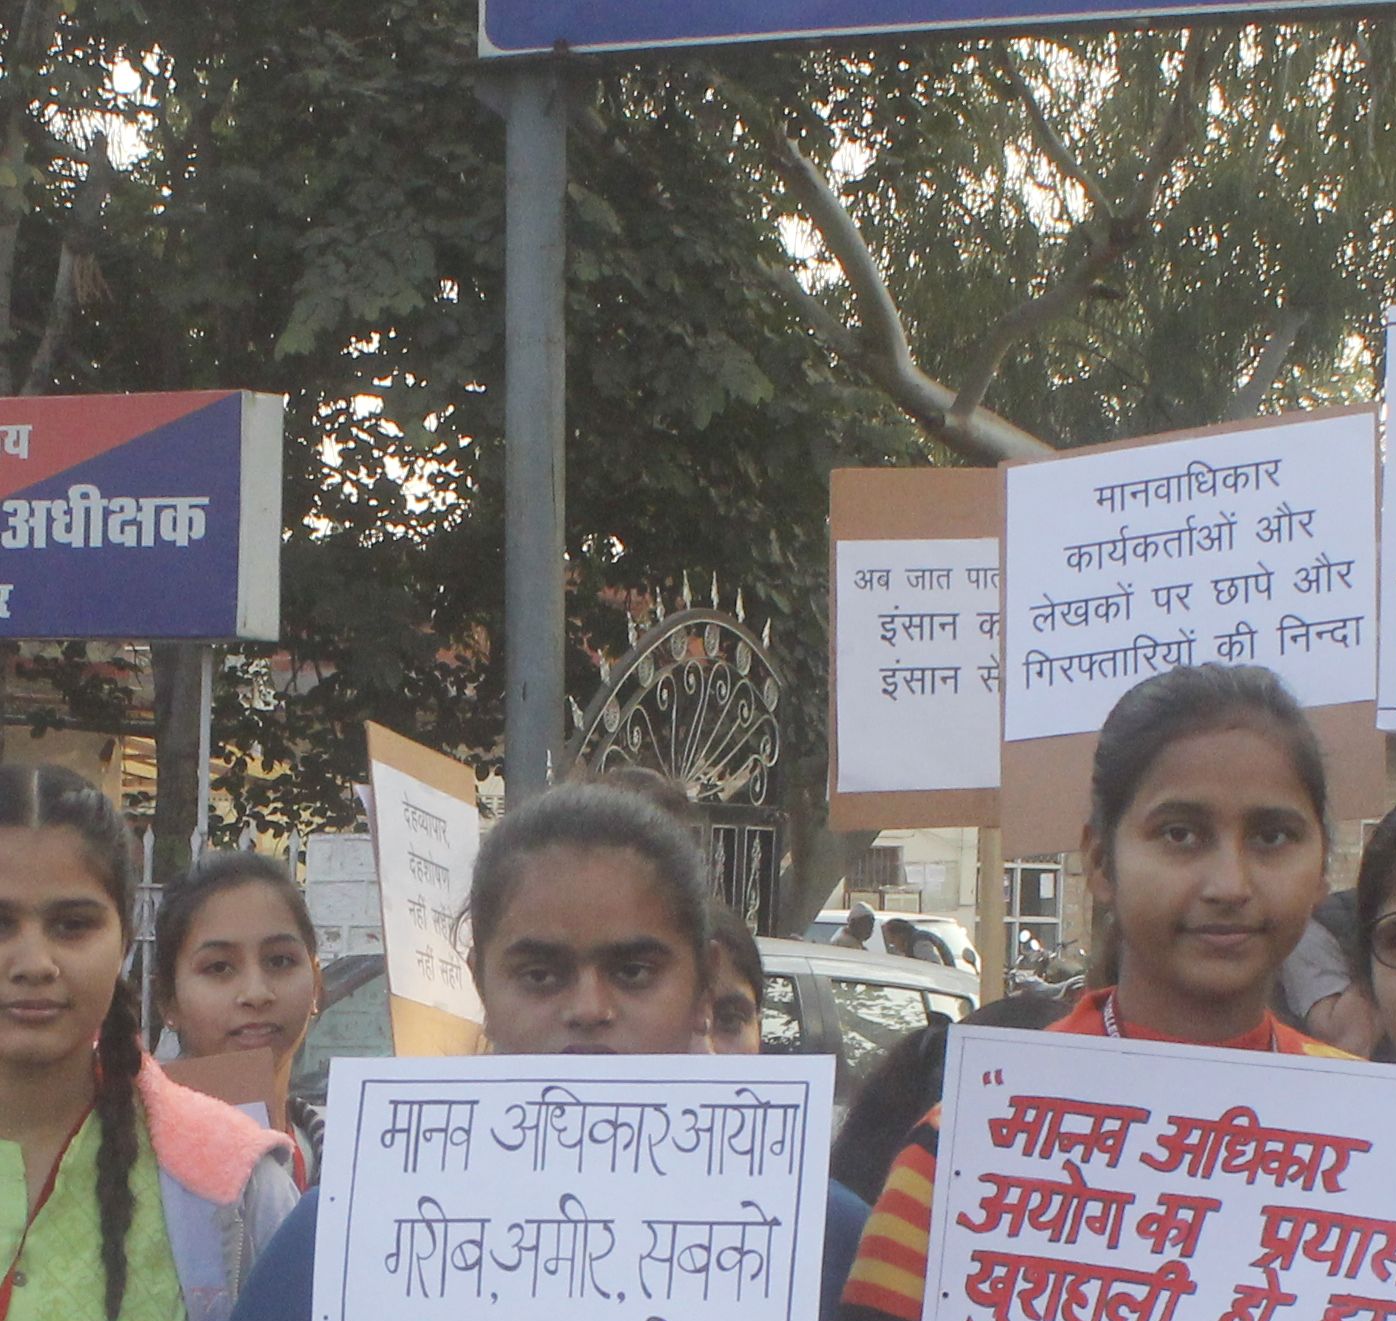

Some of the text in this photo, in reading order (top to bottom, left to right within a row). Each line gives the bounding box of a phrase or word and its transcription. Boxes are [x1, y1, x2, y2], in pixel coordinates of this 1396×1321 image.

[1, 483, 210, 549] अधीक्षक
[1094, 457, 1282, 516] मानवाधिकार
[1064, 502, 1318, 574] कार्यकर्ताओं और
[854, 568, 892, 591] अब
[905, 567, 953, 591] जात
[1030, 551, 1356, 636] लेखकों पर छापे और
[879, 604, 958, 648] इंसान
[1024, 614, 1364, 690] गिरफ्तारियों की निन्दा
[879, 657, 960, 700] इंसान
[381, 1085, 800, 1176] मानव अधिकार आयोग
[1140, 1104, 1372, 1194] अधिकार
[956, 1160, 1136, 1249] अयोग
[1136, 1193, 1221, 1259] का
[638, 1200, 782, 1302] सबको
